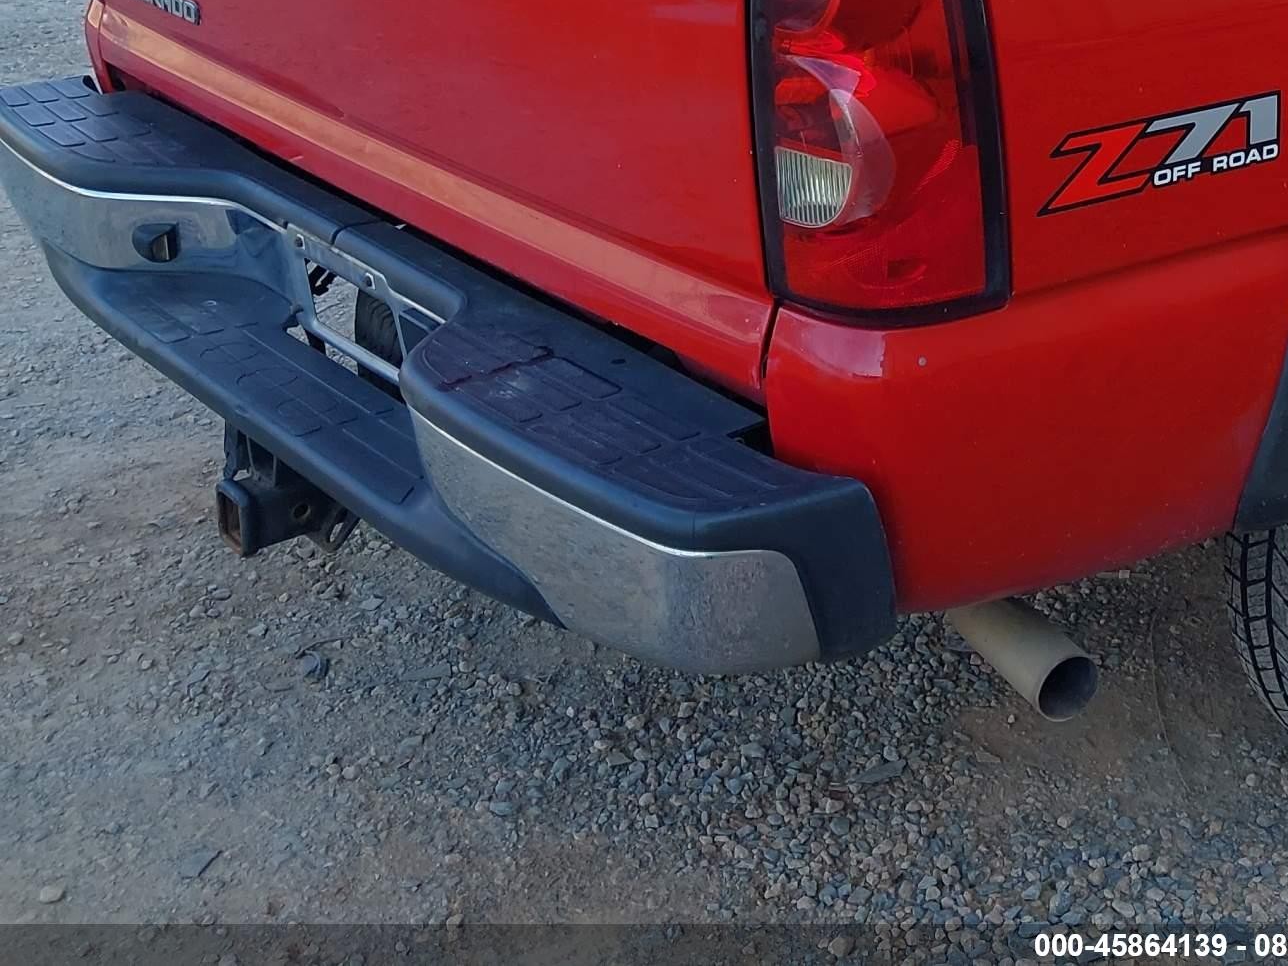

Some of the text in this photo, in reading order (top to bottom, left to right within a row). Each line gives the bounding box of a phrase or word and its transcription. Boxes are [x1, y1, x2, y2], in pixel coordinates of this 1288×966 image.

[1033, 89, 1281, 218] Z71
[1153, 143, 1279, 186] OFF ROAD
